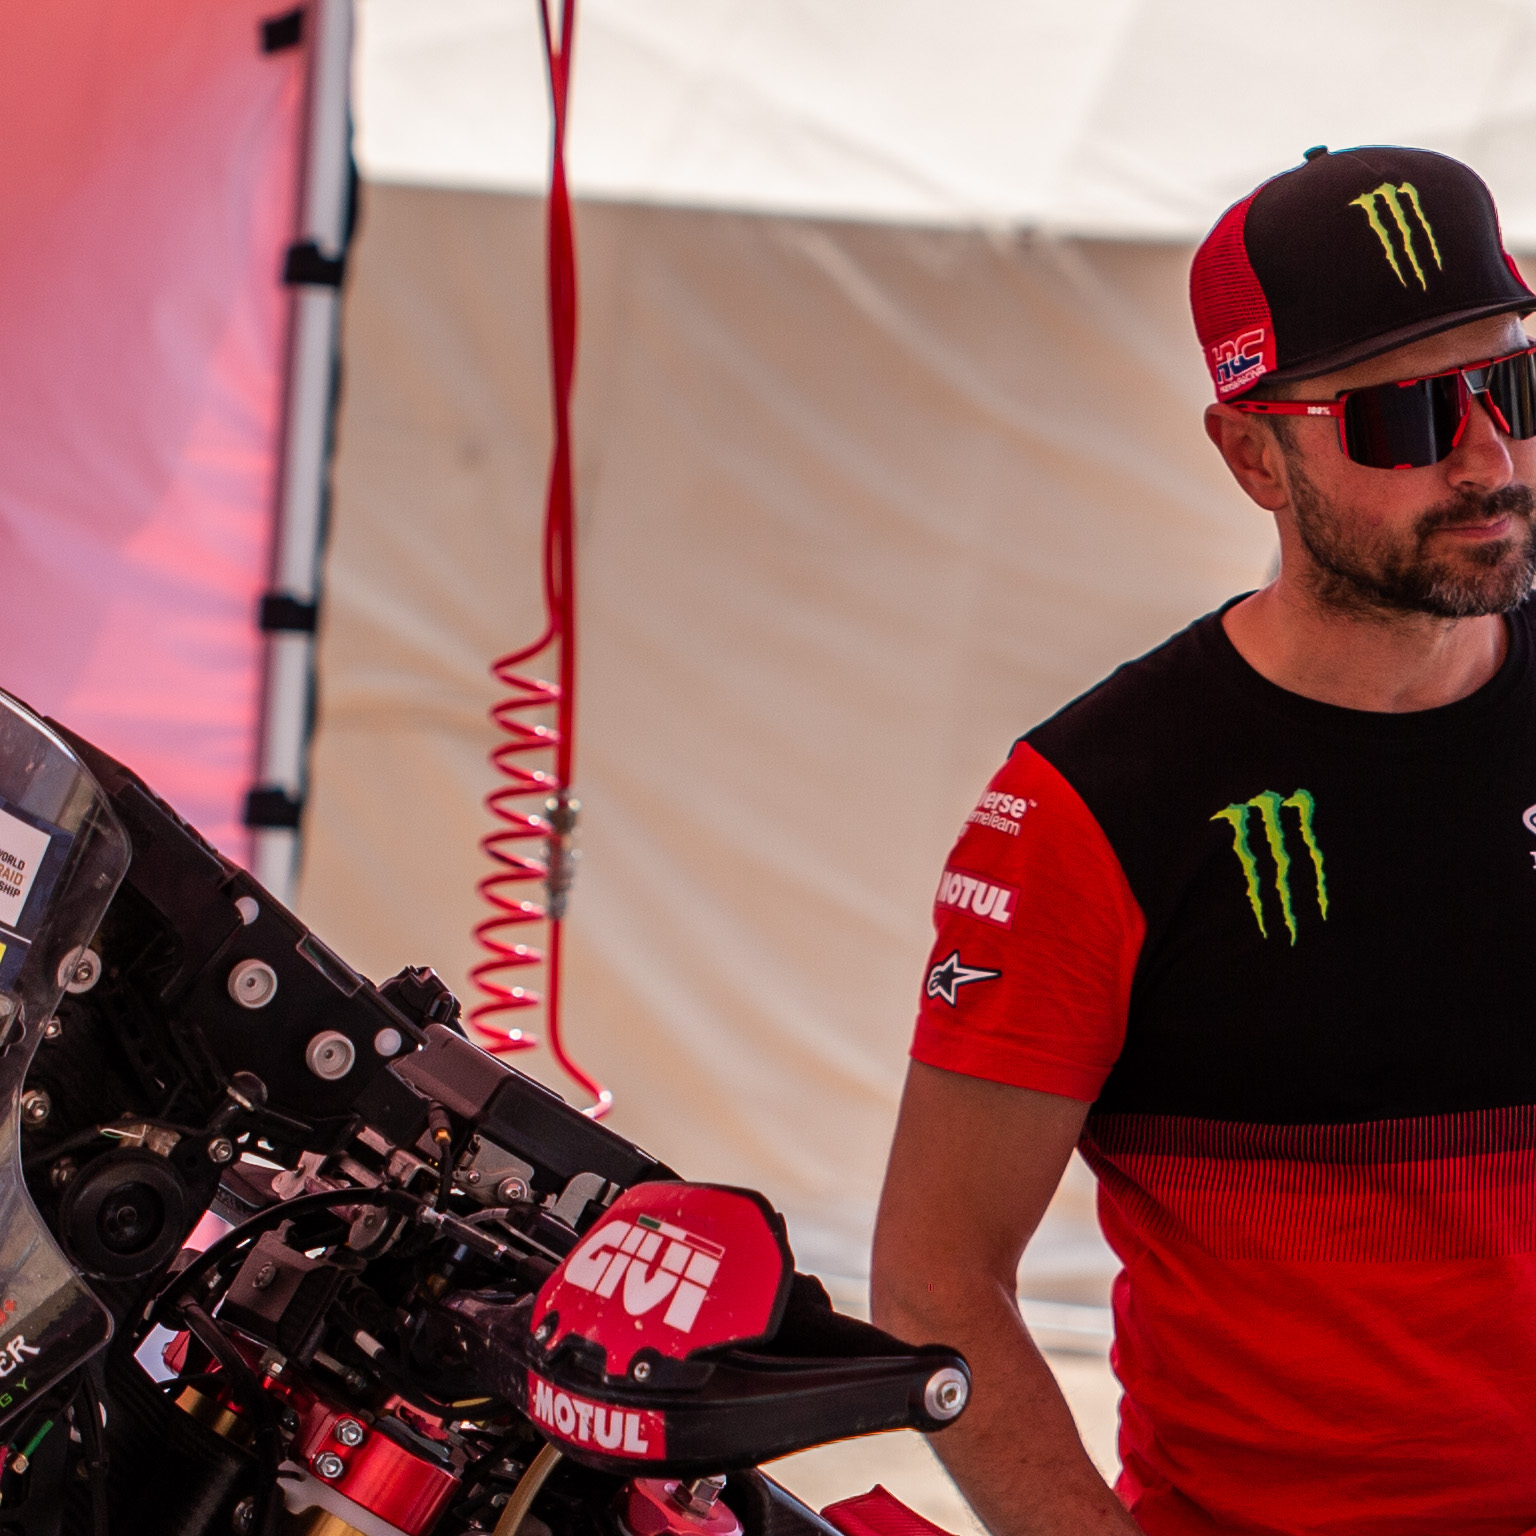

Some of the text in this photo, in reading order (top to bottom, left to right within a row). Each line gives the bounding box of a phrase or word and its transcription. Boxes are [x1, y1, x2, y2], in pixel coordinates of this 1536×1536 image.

[1307, 406, 1331, 415] 100%
[564, 1219, 721, 1334] GIVI
[534, 1380, 649, 1455] MOTUL
